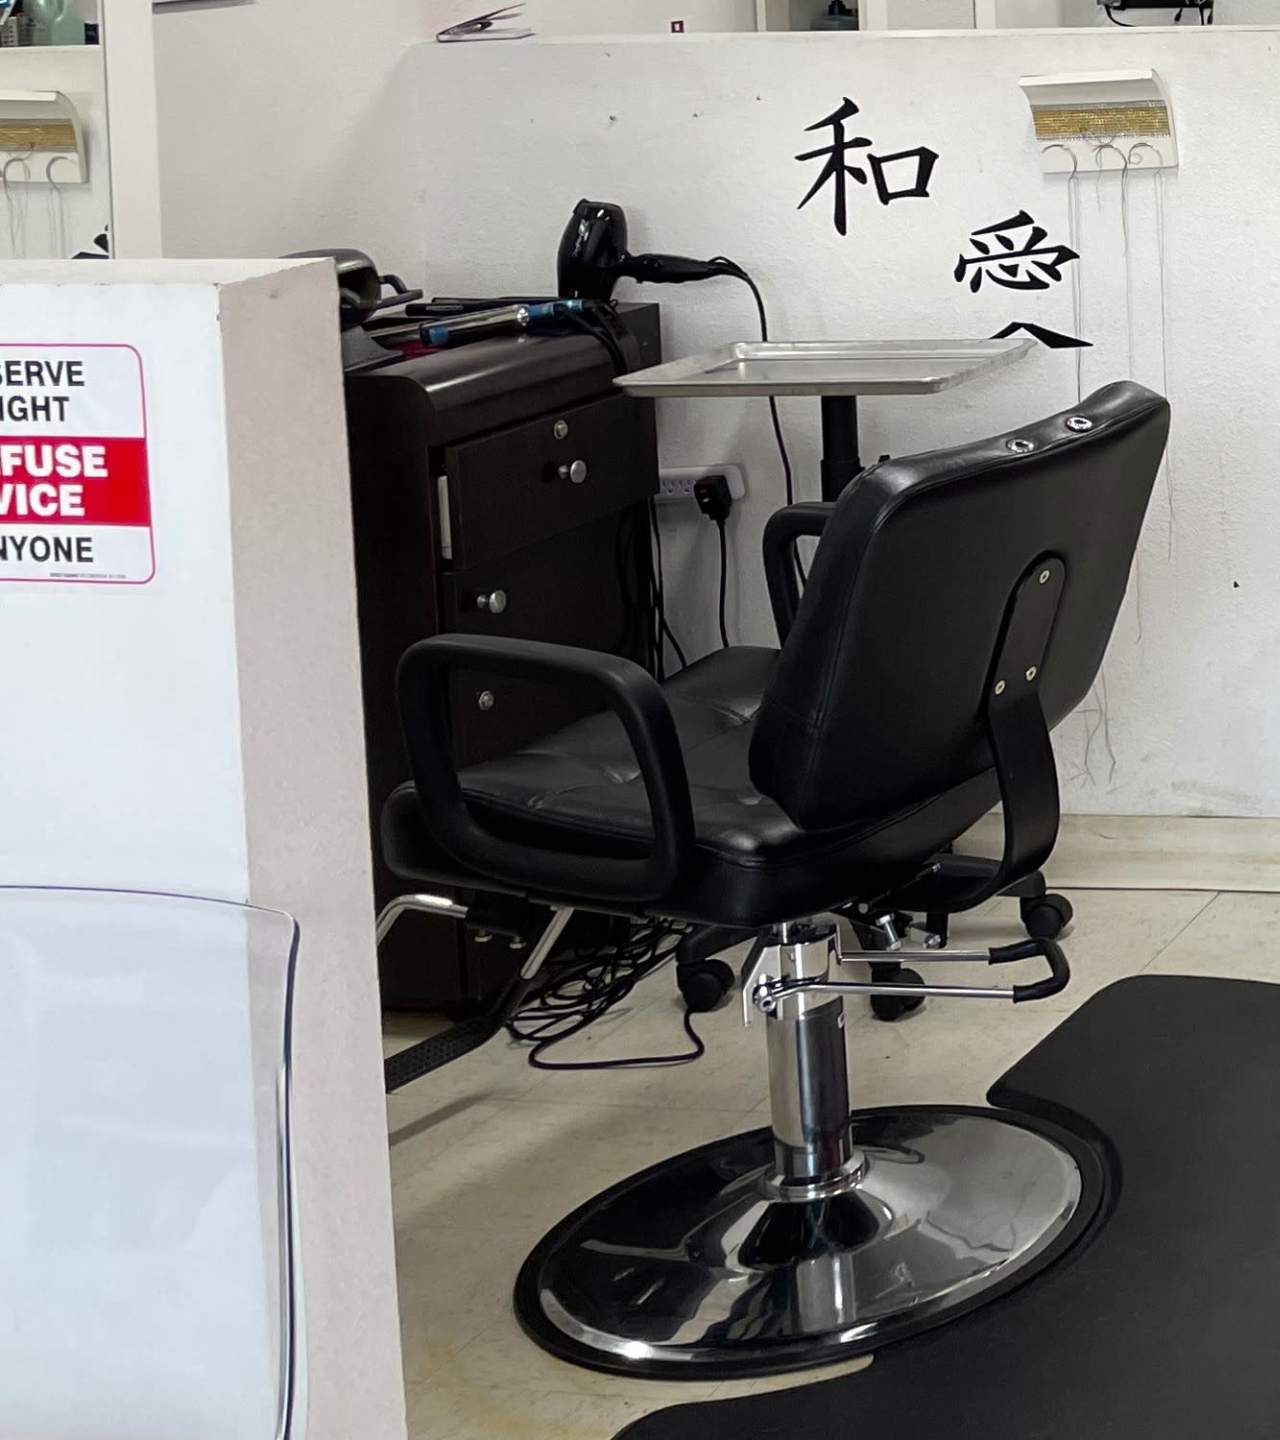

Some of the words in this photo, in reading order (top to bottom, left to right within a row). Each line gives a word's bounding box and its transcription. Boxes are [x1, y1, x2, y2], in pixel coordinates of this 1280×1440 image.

[794, 96, 940, 237] 和
[0, 360, 85, 387] ERVE
[0, 443, 108, 478] FUSE
